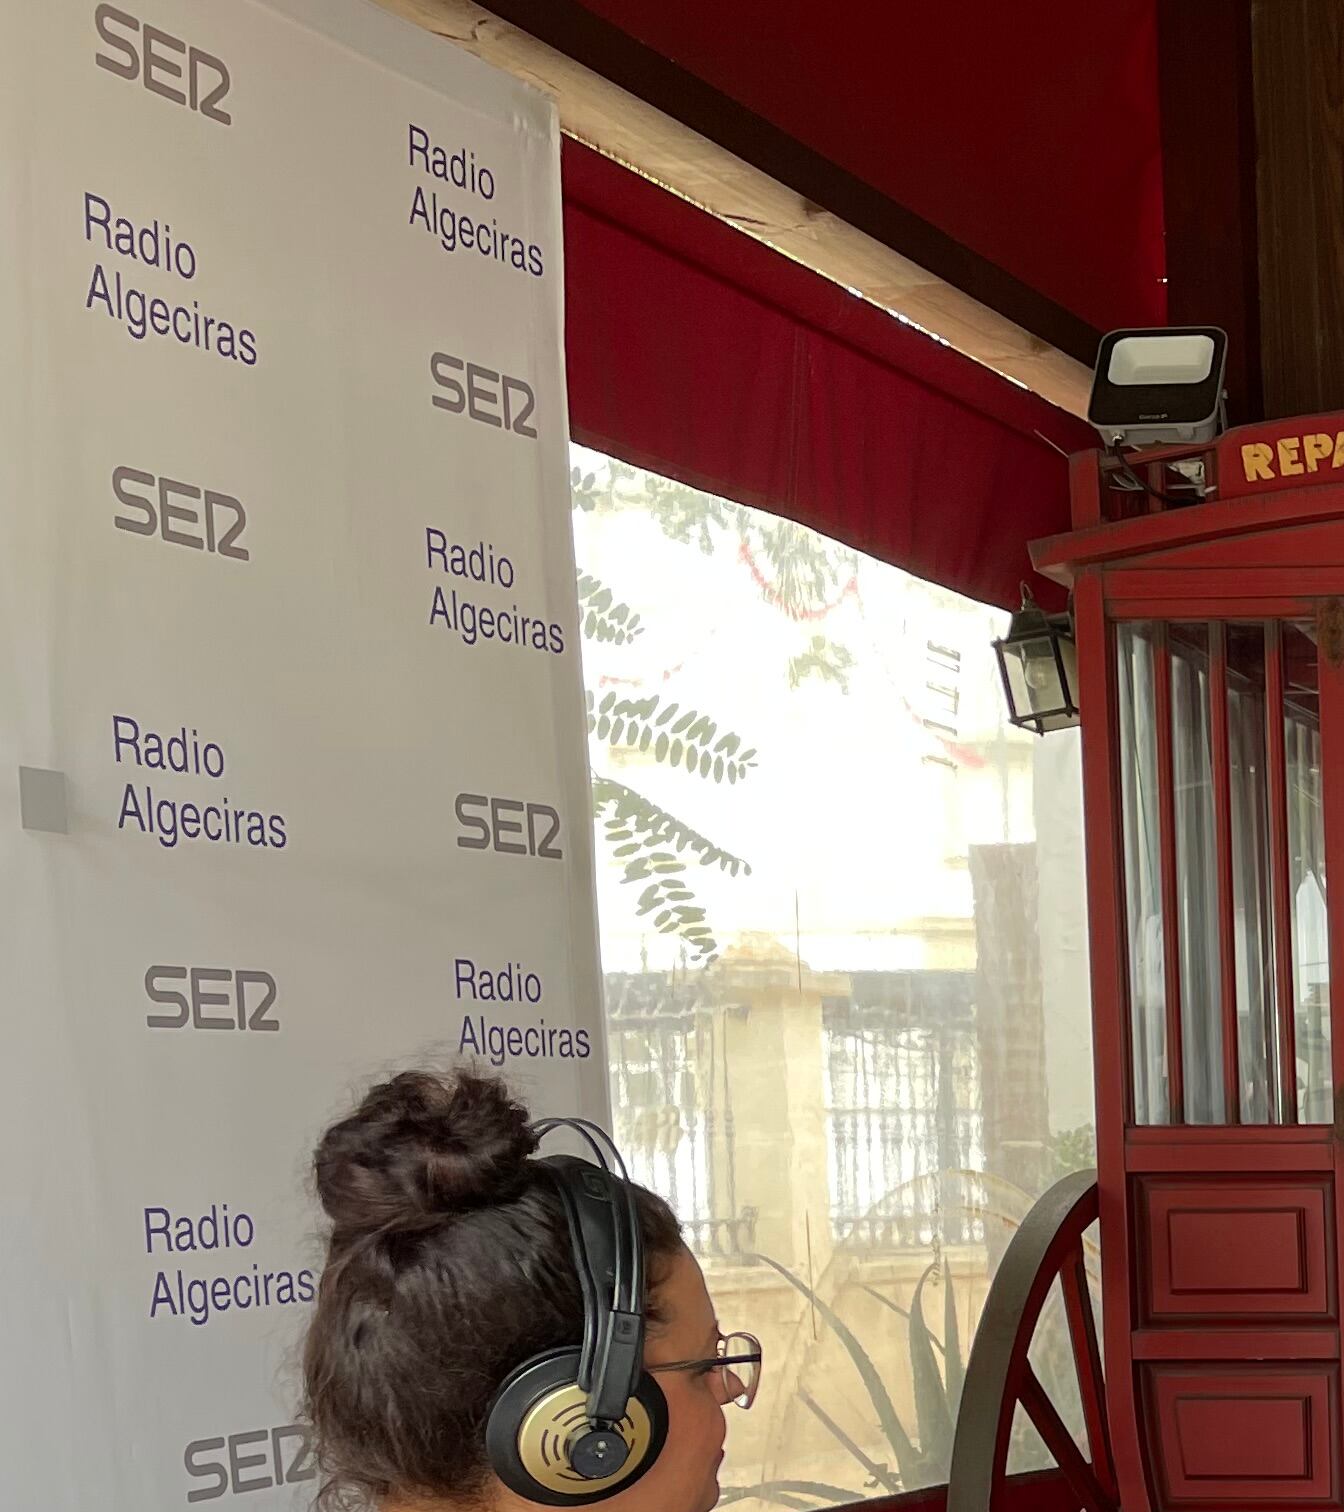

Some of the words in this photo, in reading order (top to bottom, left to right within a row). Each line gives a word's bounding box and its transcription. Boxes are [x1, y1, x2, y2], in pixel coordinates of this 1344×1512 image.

[95, 4, 232, 126] SER
[409, 124, 495, 199] Radio
[84, 192, 196, 280] Radio
[409, 186, 544, 276] Algeciras
[85, 265, 257, 364] Algeciras
[430, 352, 538, 439] SER
[112, 466, 249, 561] SER
[425, 528, 514, 588] Radio
[429, 587, 564, 654] Algeciras
[113, 716, 225, 778] Radio
[119, 784, 287, 848] Algeciras
[455, 793, 562, 859] SER
[144, 965, 280, 1031] SER
[455, 959, 541, 1004] Radio
[459, 1016, 590, 1066] Algeciras
[144, 1205, 254, 1254] Radio
[150, 1265, 316, 1325] Algeciras
